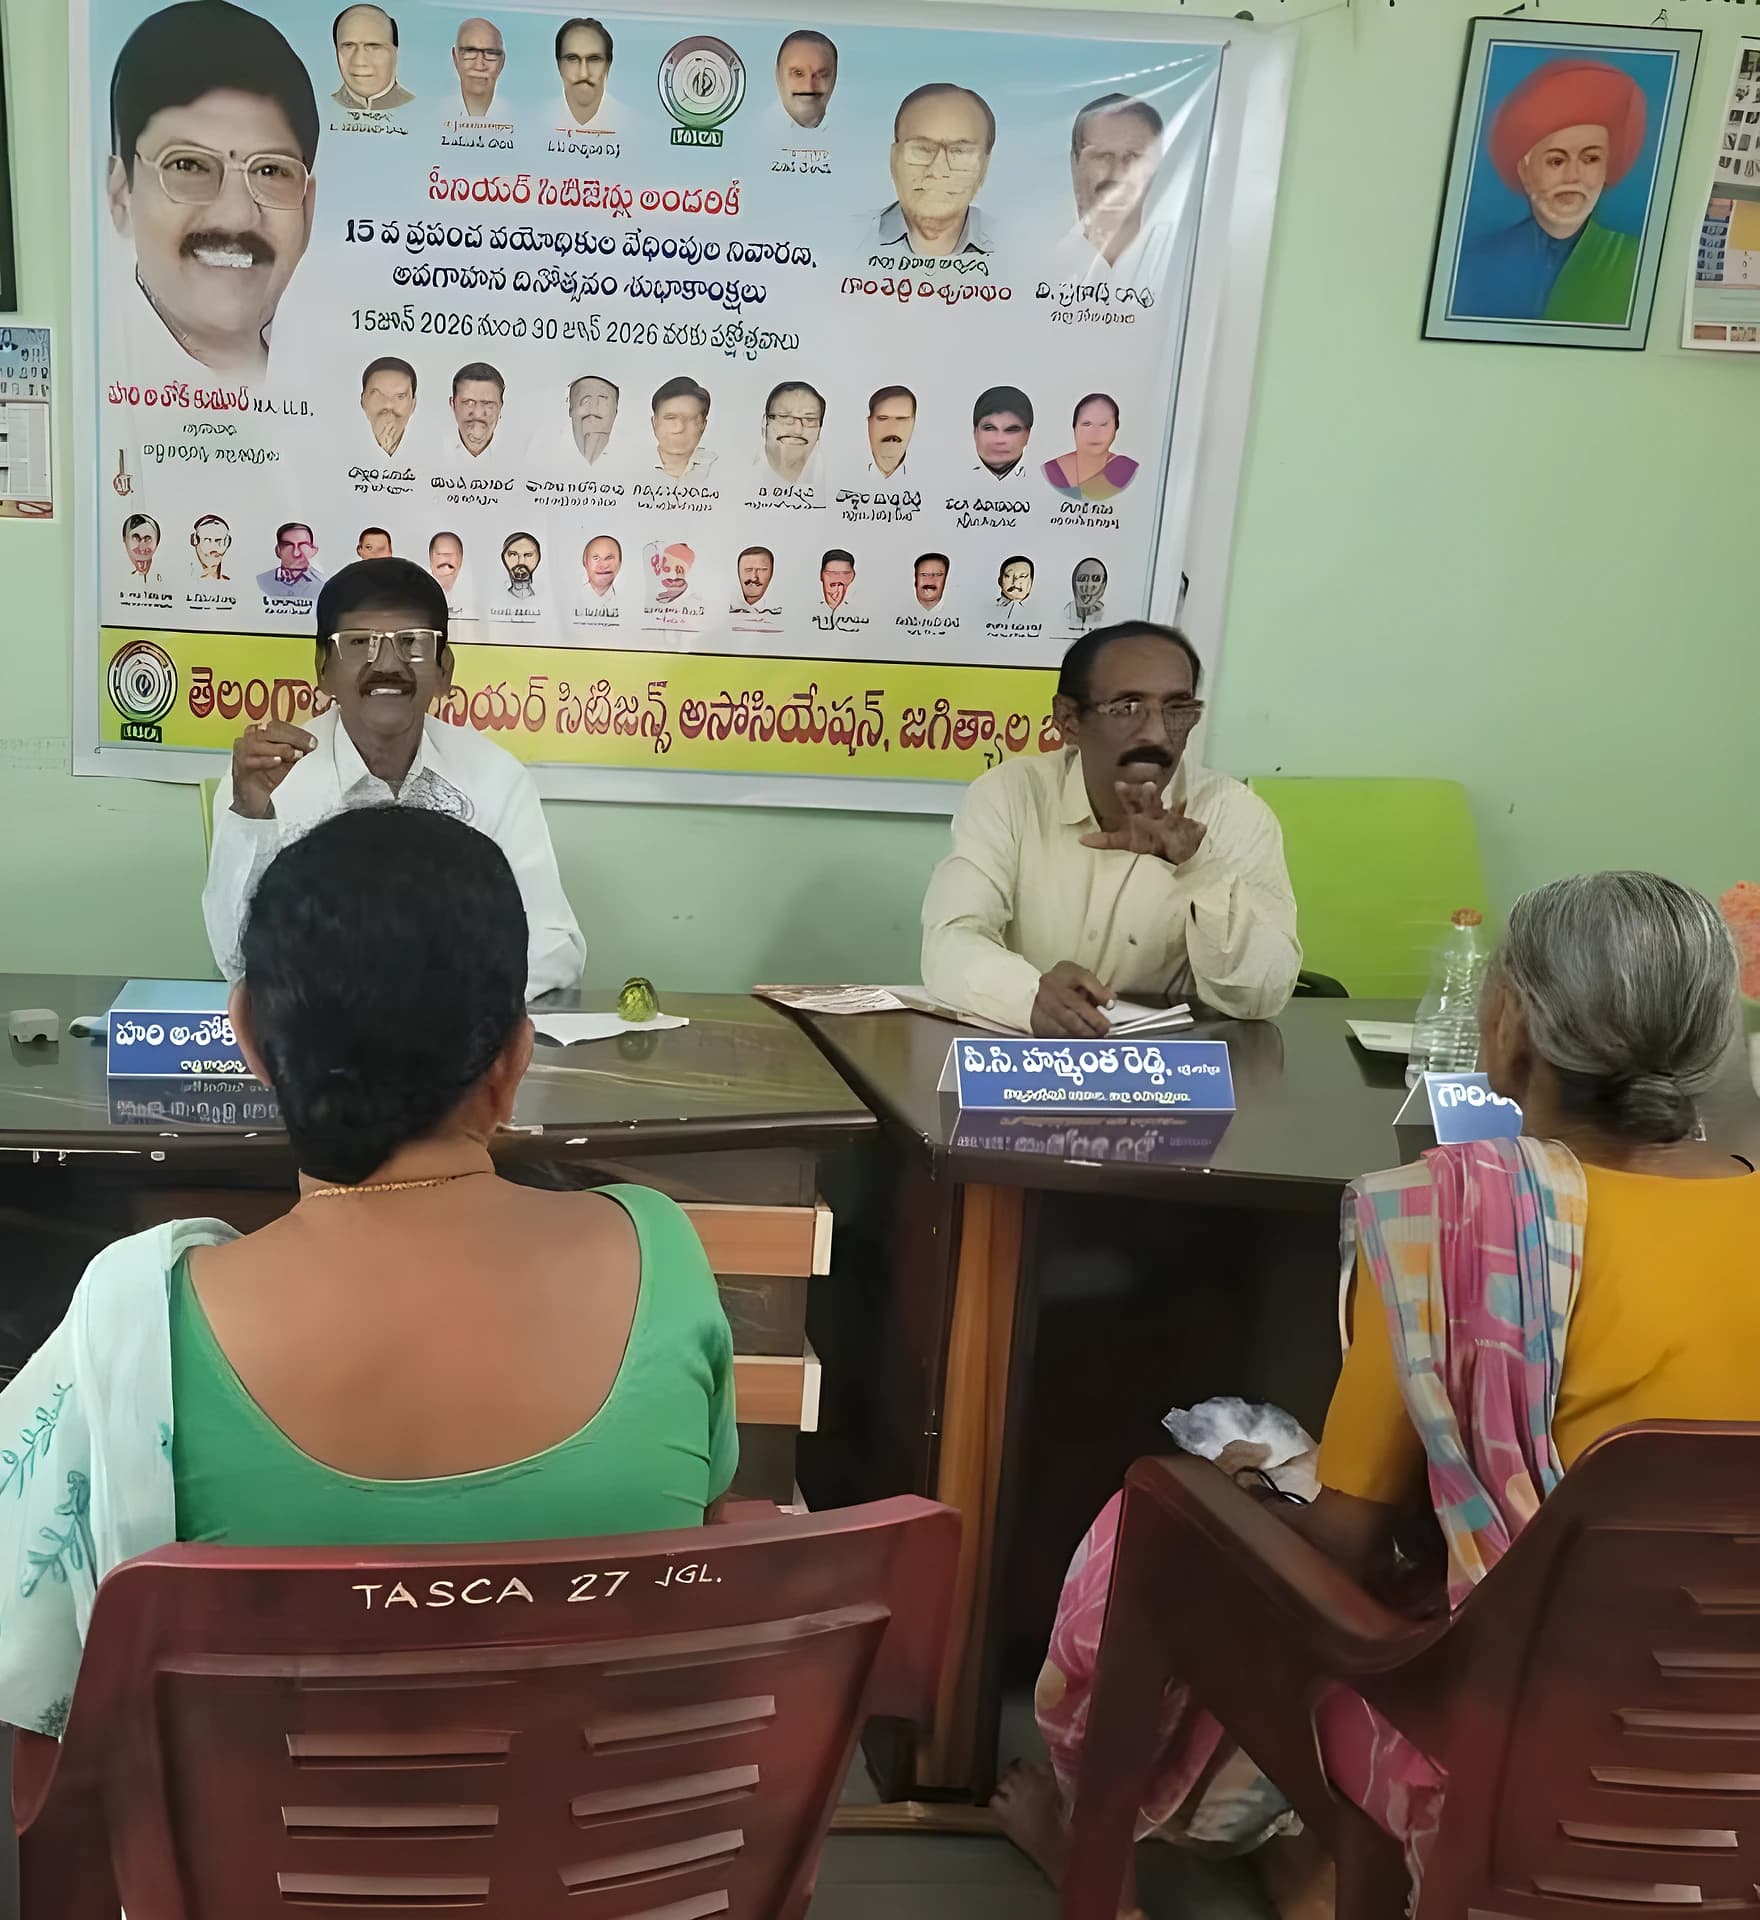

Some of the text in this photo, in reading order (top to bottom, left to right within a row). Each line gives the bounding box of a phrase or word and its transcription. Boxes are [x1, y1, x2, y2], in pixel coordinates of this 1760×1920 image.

[428, 166, 531, 203] సీనియర్
[345, 219, 374, 243] 15
[420, 311, 474, 337] 2026
[531, 317, 558, 340] 30
[606, 321, 658, 346] 2026
[435, 675, 549, 732] నియర్
[679, 682, 891, 757] అసోసియేషన్,
[352, 1563, 723, 1610] TASCA 27 JGL.
